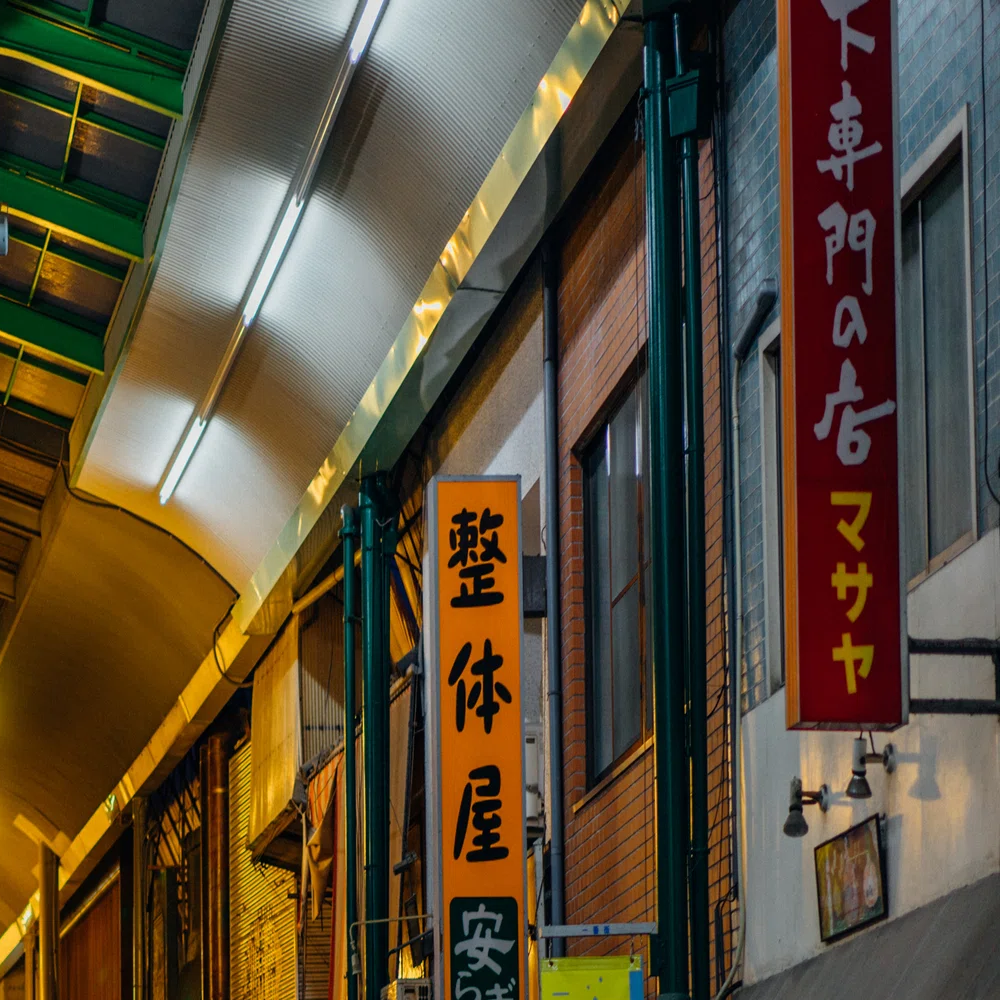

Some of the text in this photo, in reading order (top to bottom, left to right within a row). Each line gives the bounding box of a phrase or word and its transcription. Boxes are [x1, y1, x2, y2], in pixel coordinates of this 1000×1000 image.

[447, 506, 513, 863] 整体屋
[830, 491, 875, 695] マサヤ
